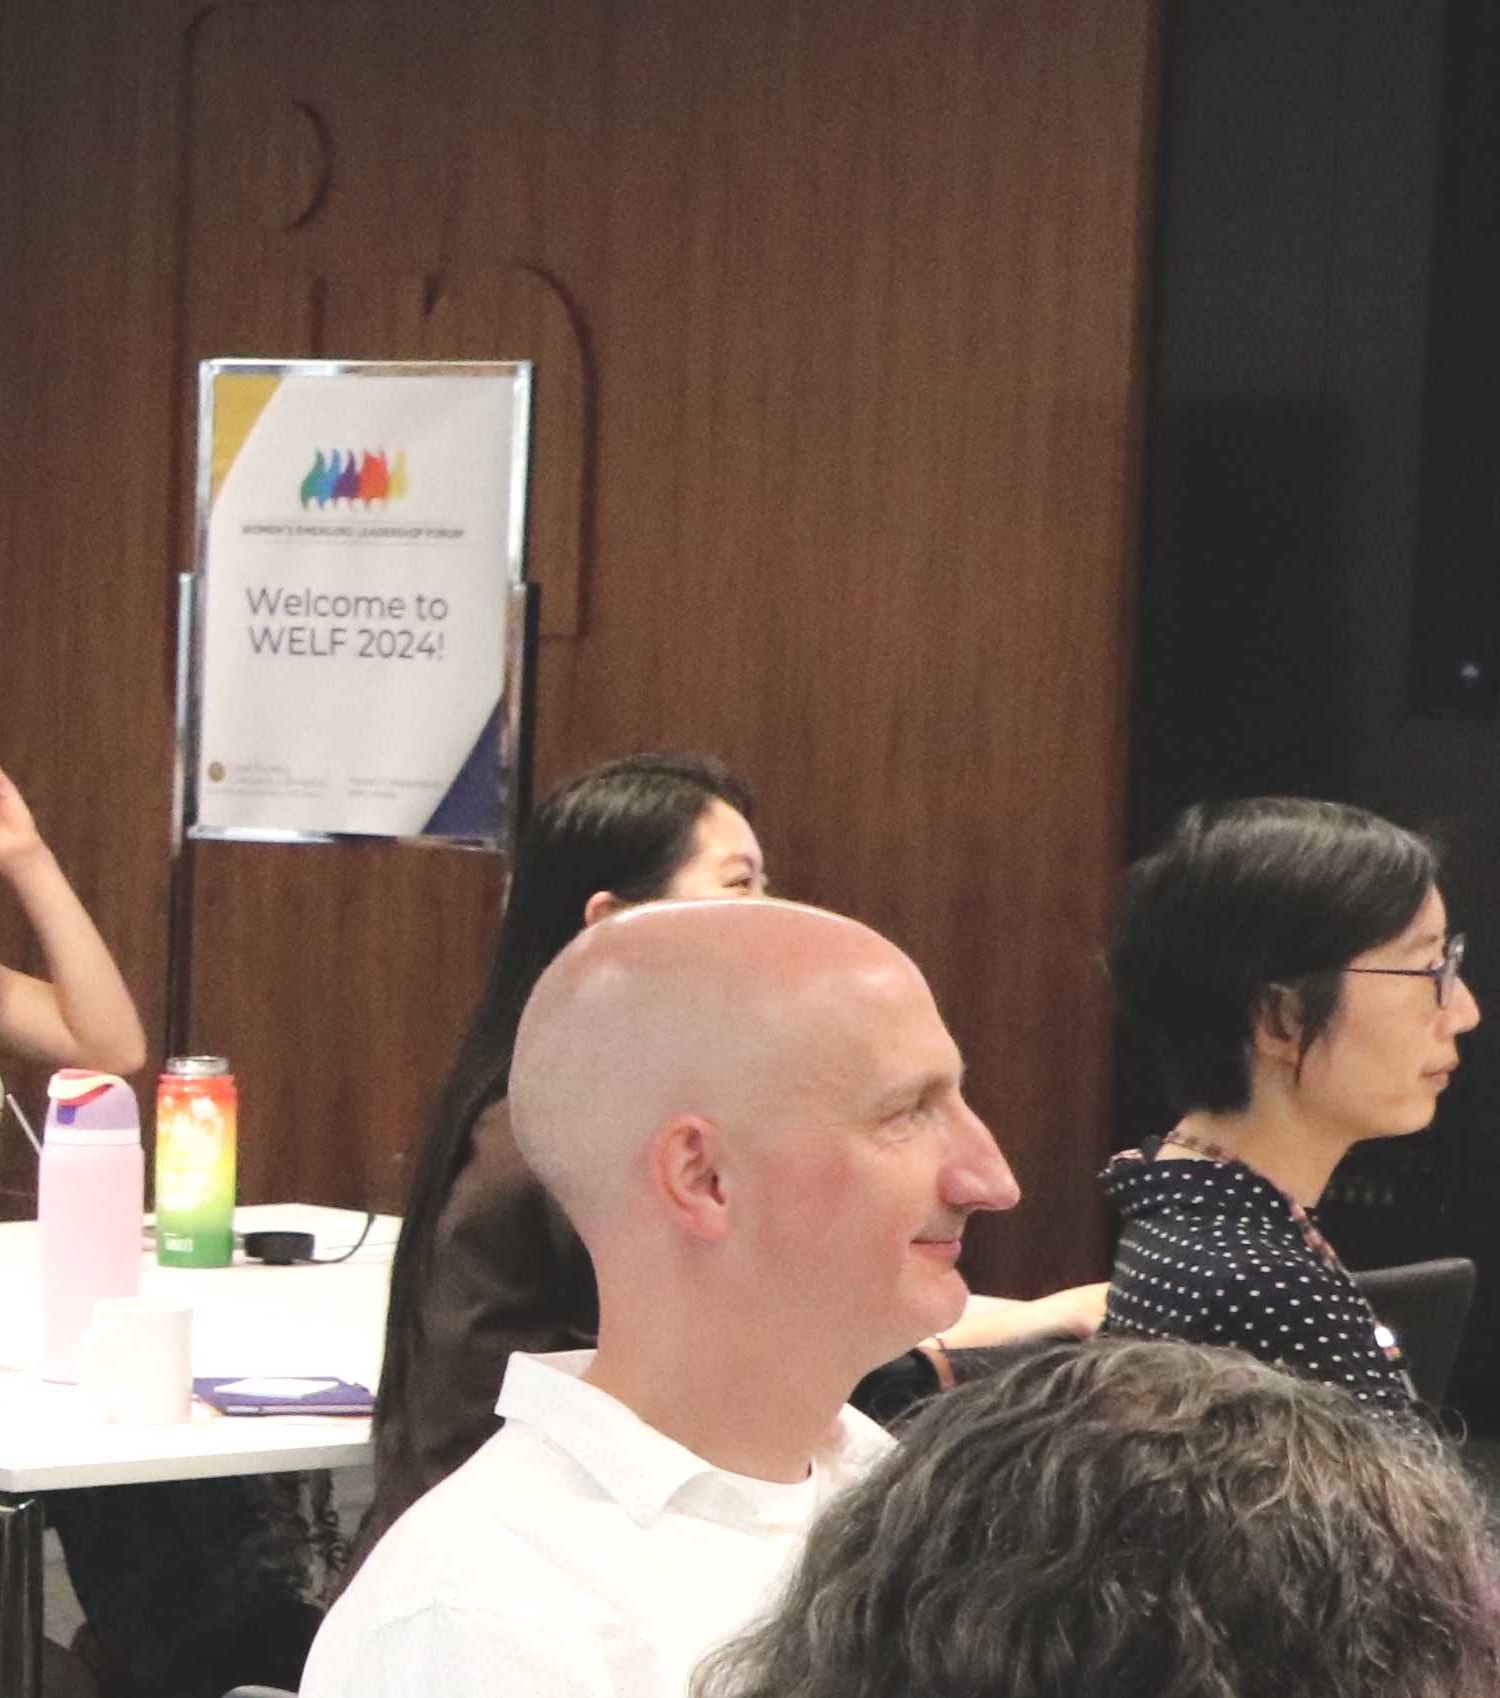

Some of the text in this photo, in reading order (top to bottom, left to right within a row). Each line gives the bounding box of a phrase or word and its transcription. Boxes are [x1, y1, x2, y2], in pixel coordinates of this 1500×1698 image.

[246, 587, 449, 621] Welcome to
[249, 626, 445, 661] WELF 2024!
